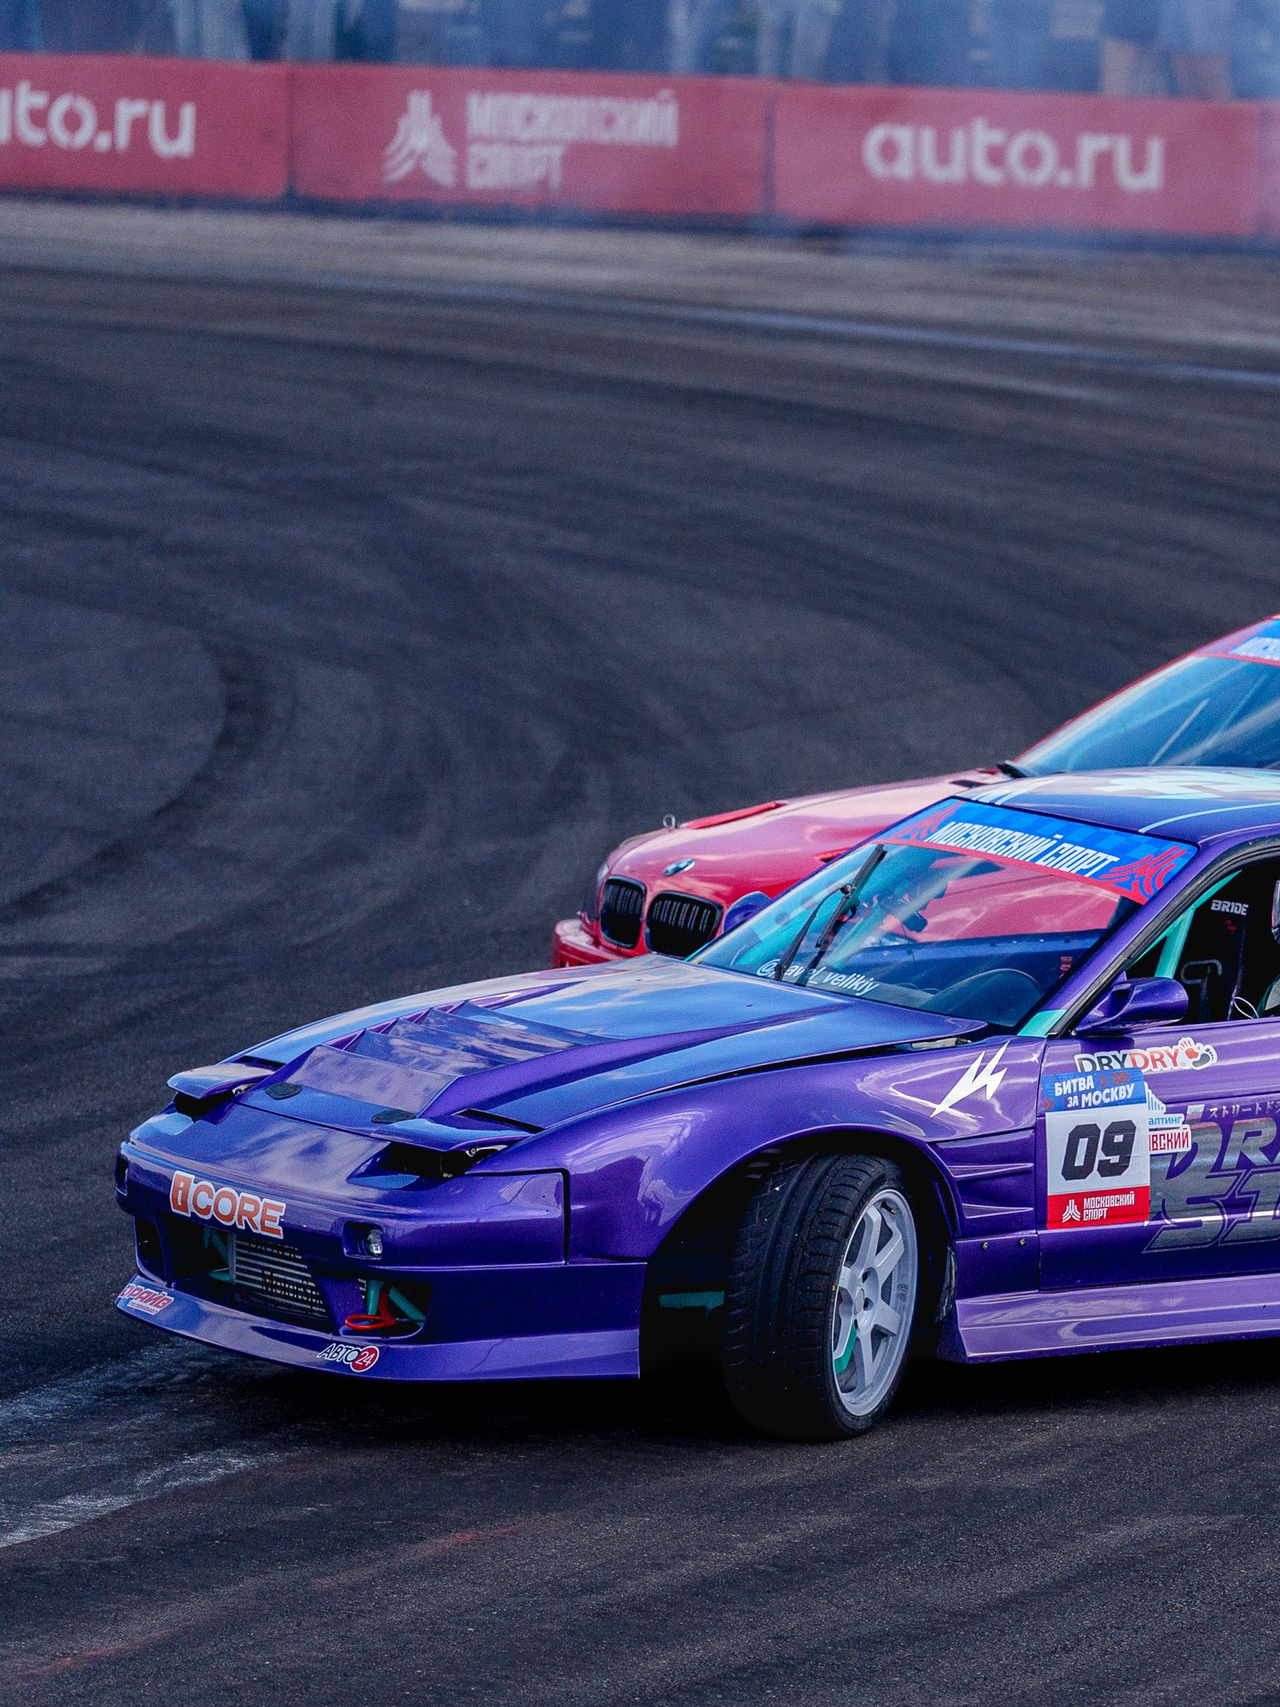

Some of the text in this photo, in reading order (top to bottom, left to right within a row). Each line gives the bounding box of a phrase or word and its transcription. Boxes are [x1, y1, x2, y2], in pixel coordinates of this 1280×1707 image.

[0, 80, 196, 158] to.ru
[862, 117, 1166, 192] auto.ru
[923, 821, 1120, 878] МОСКОВСКИЙ СПОРТ
[1211, 899, 1249, 916] BRIDE
[1054, 1075, 1095, 1097] БИТВА
[1067, 1083, 1135, 1108] ЗА МОСКВУ
[1148, 1116, 1182, 1126] алтинг
[1061, 1120, 1136, 1181] 09
[1149, 1127, 1189, 1151] ВСКИЙ
[1083, 1191, 1135, 1209] МОСКОВСКИЙ
[1083, 1207, 1108, 1221] СПОРТ
